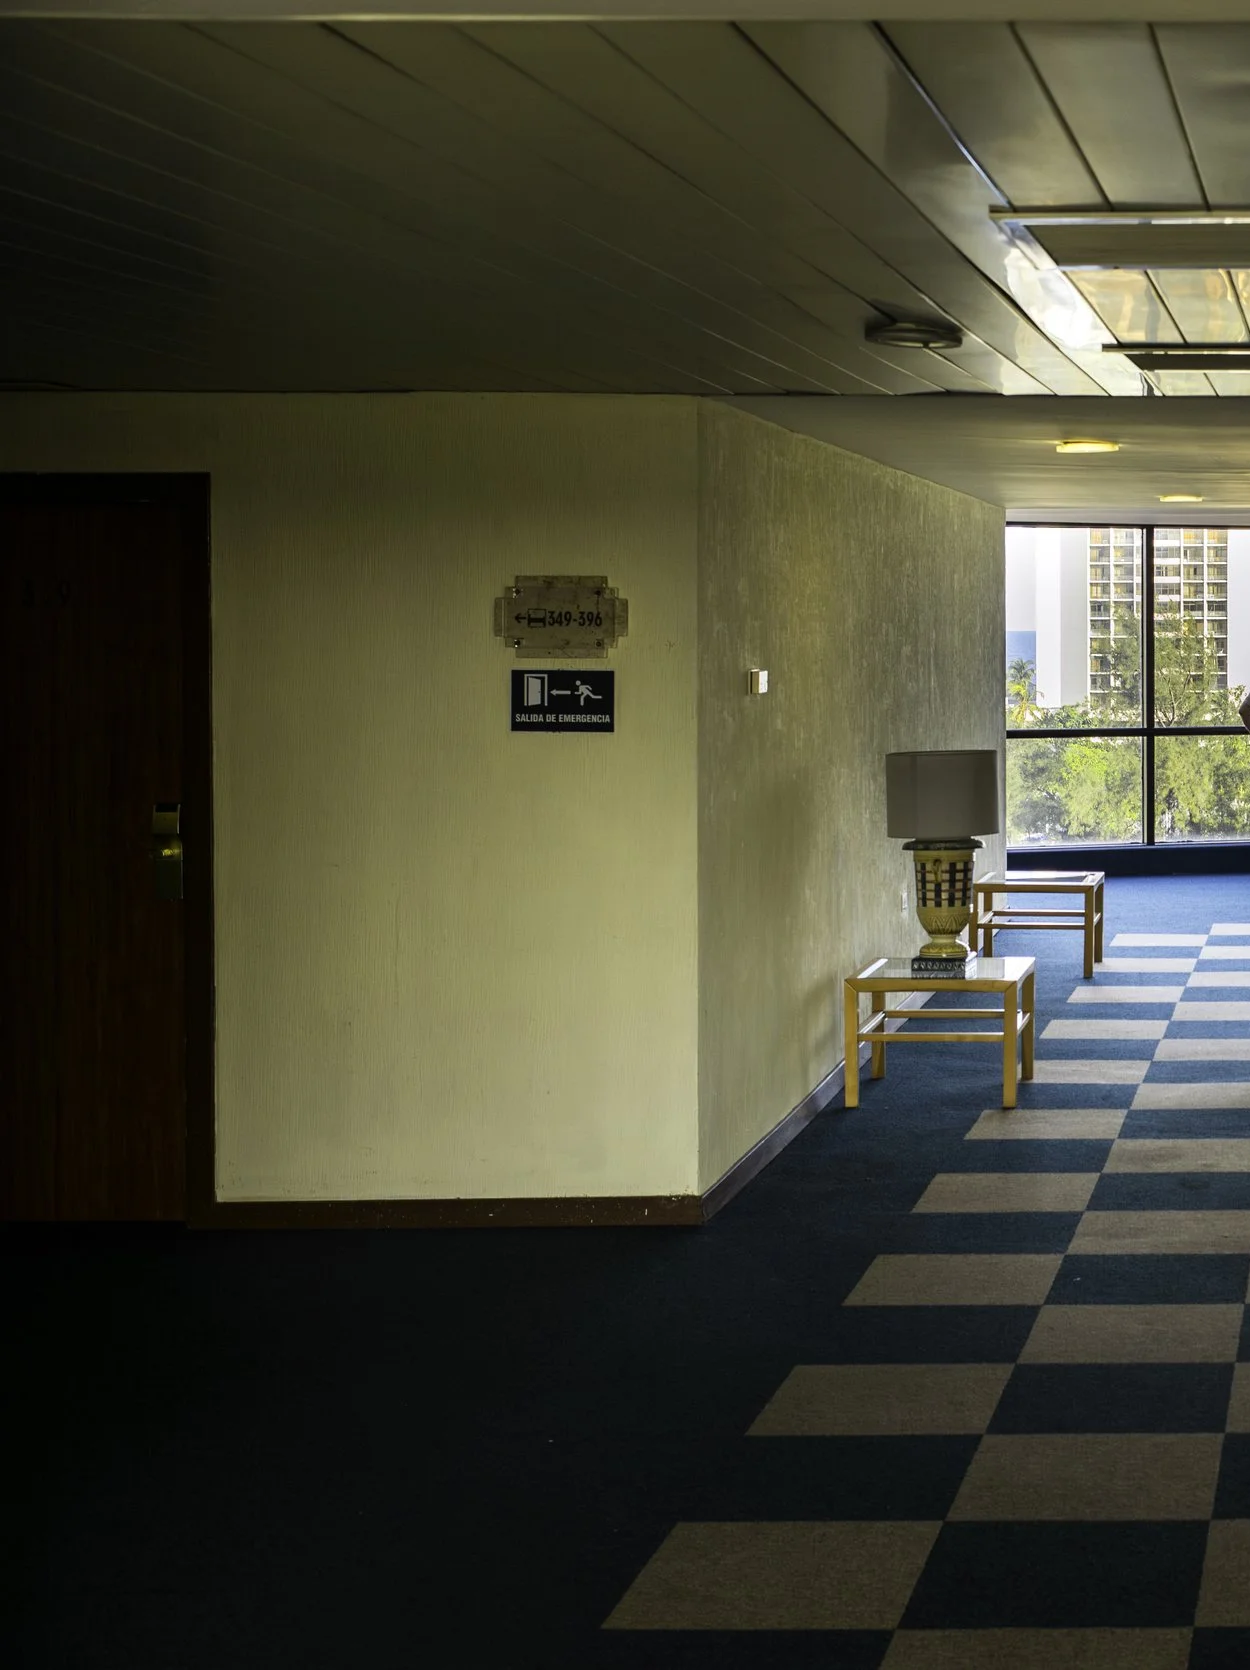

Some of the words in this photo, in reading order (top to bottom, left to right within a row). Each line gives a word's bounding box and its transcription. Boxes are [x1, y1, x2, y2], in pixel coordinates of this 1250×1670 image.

[547, 611, 603, 627] 349-396
[515, 713, 544, 723] SALIDA
[546, 713, 556, 723] DE
[558, 713, 611, 723] EMERGENCIA
